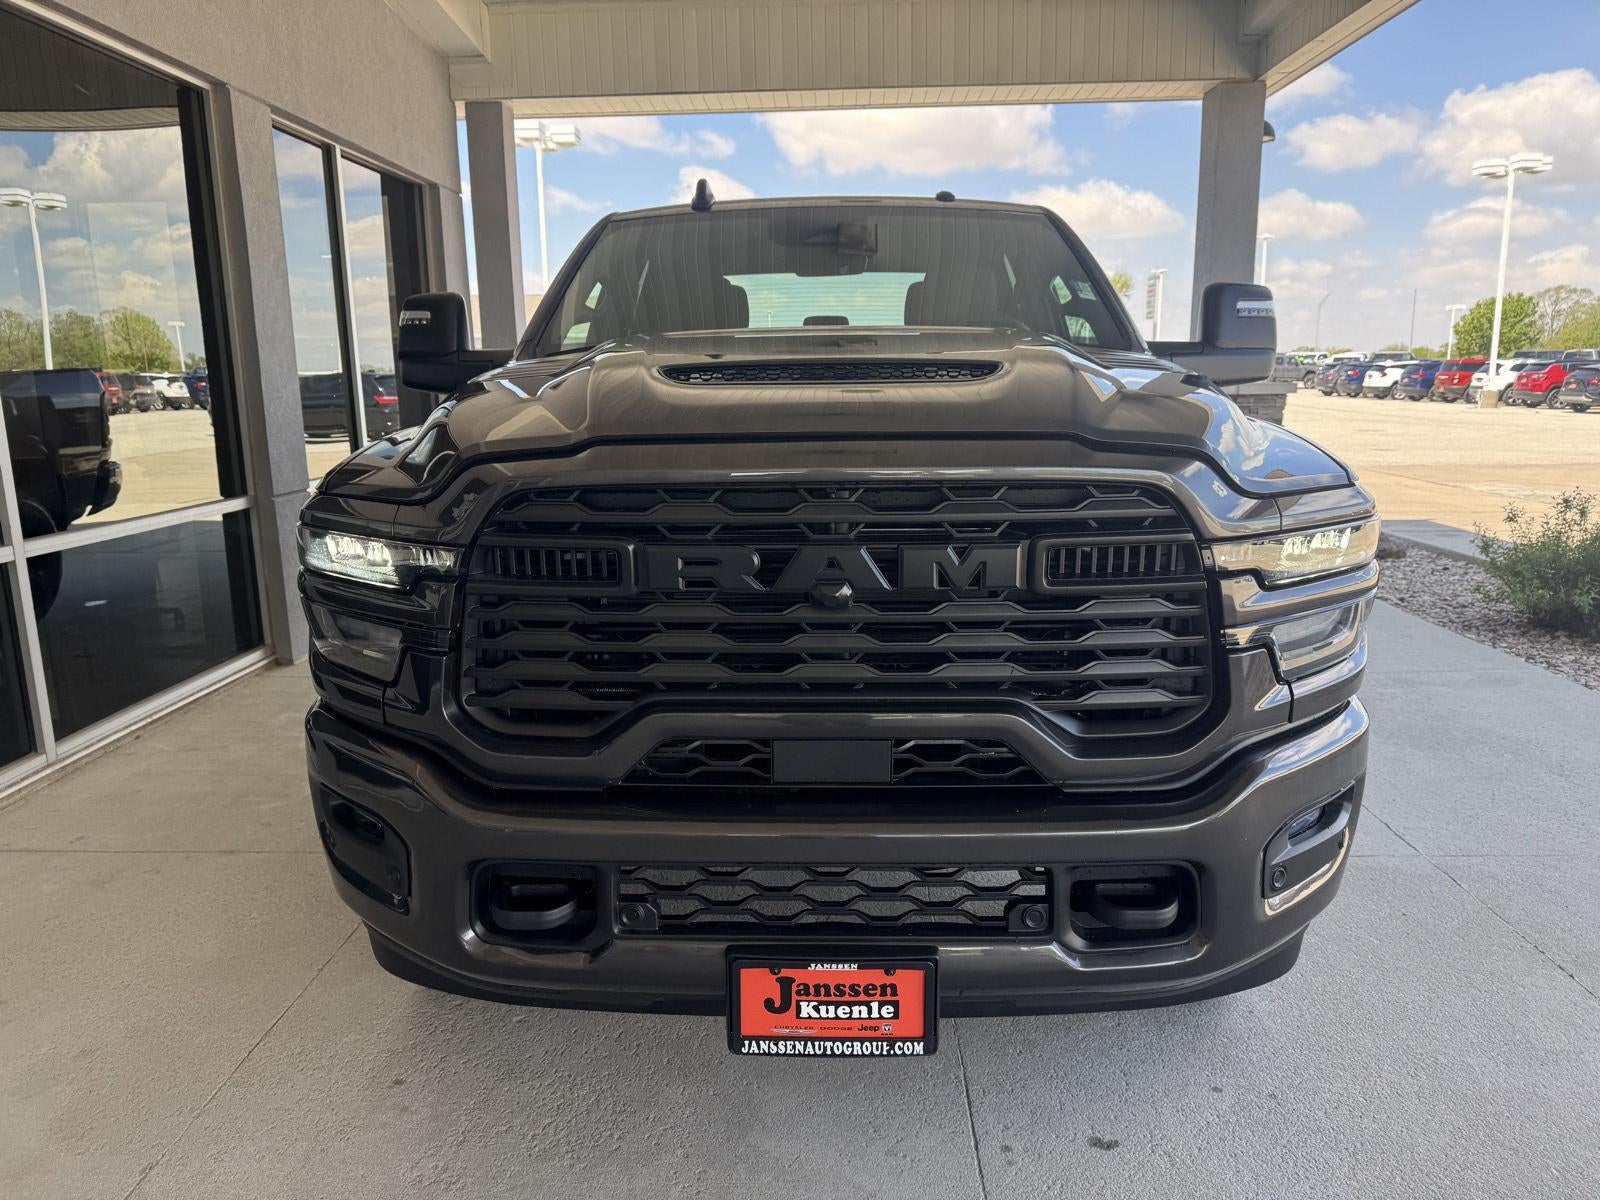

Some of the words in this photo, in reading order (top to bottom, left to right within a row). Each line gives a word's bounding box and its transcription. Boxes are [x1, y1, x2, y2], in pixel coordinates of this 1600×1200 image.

[645, 544, 1021, 591] RAM
[807, 963, 858, 971] JANSSEN
[763, 976, 899, 1014] Janssen
[799, 1001, 895, 1019] Kuenle
[857, 1024, 880, 1032] Jeep
